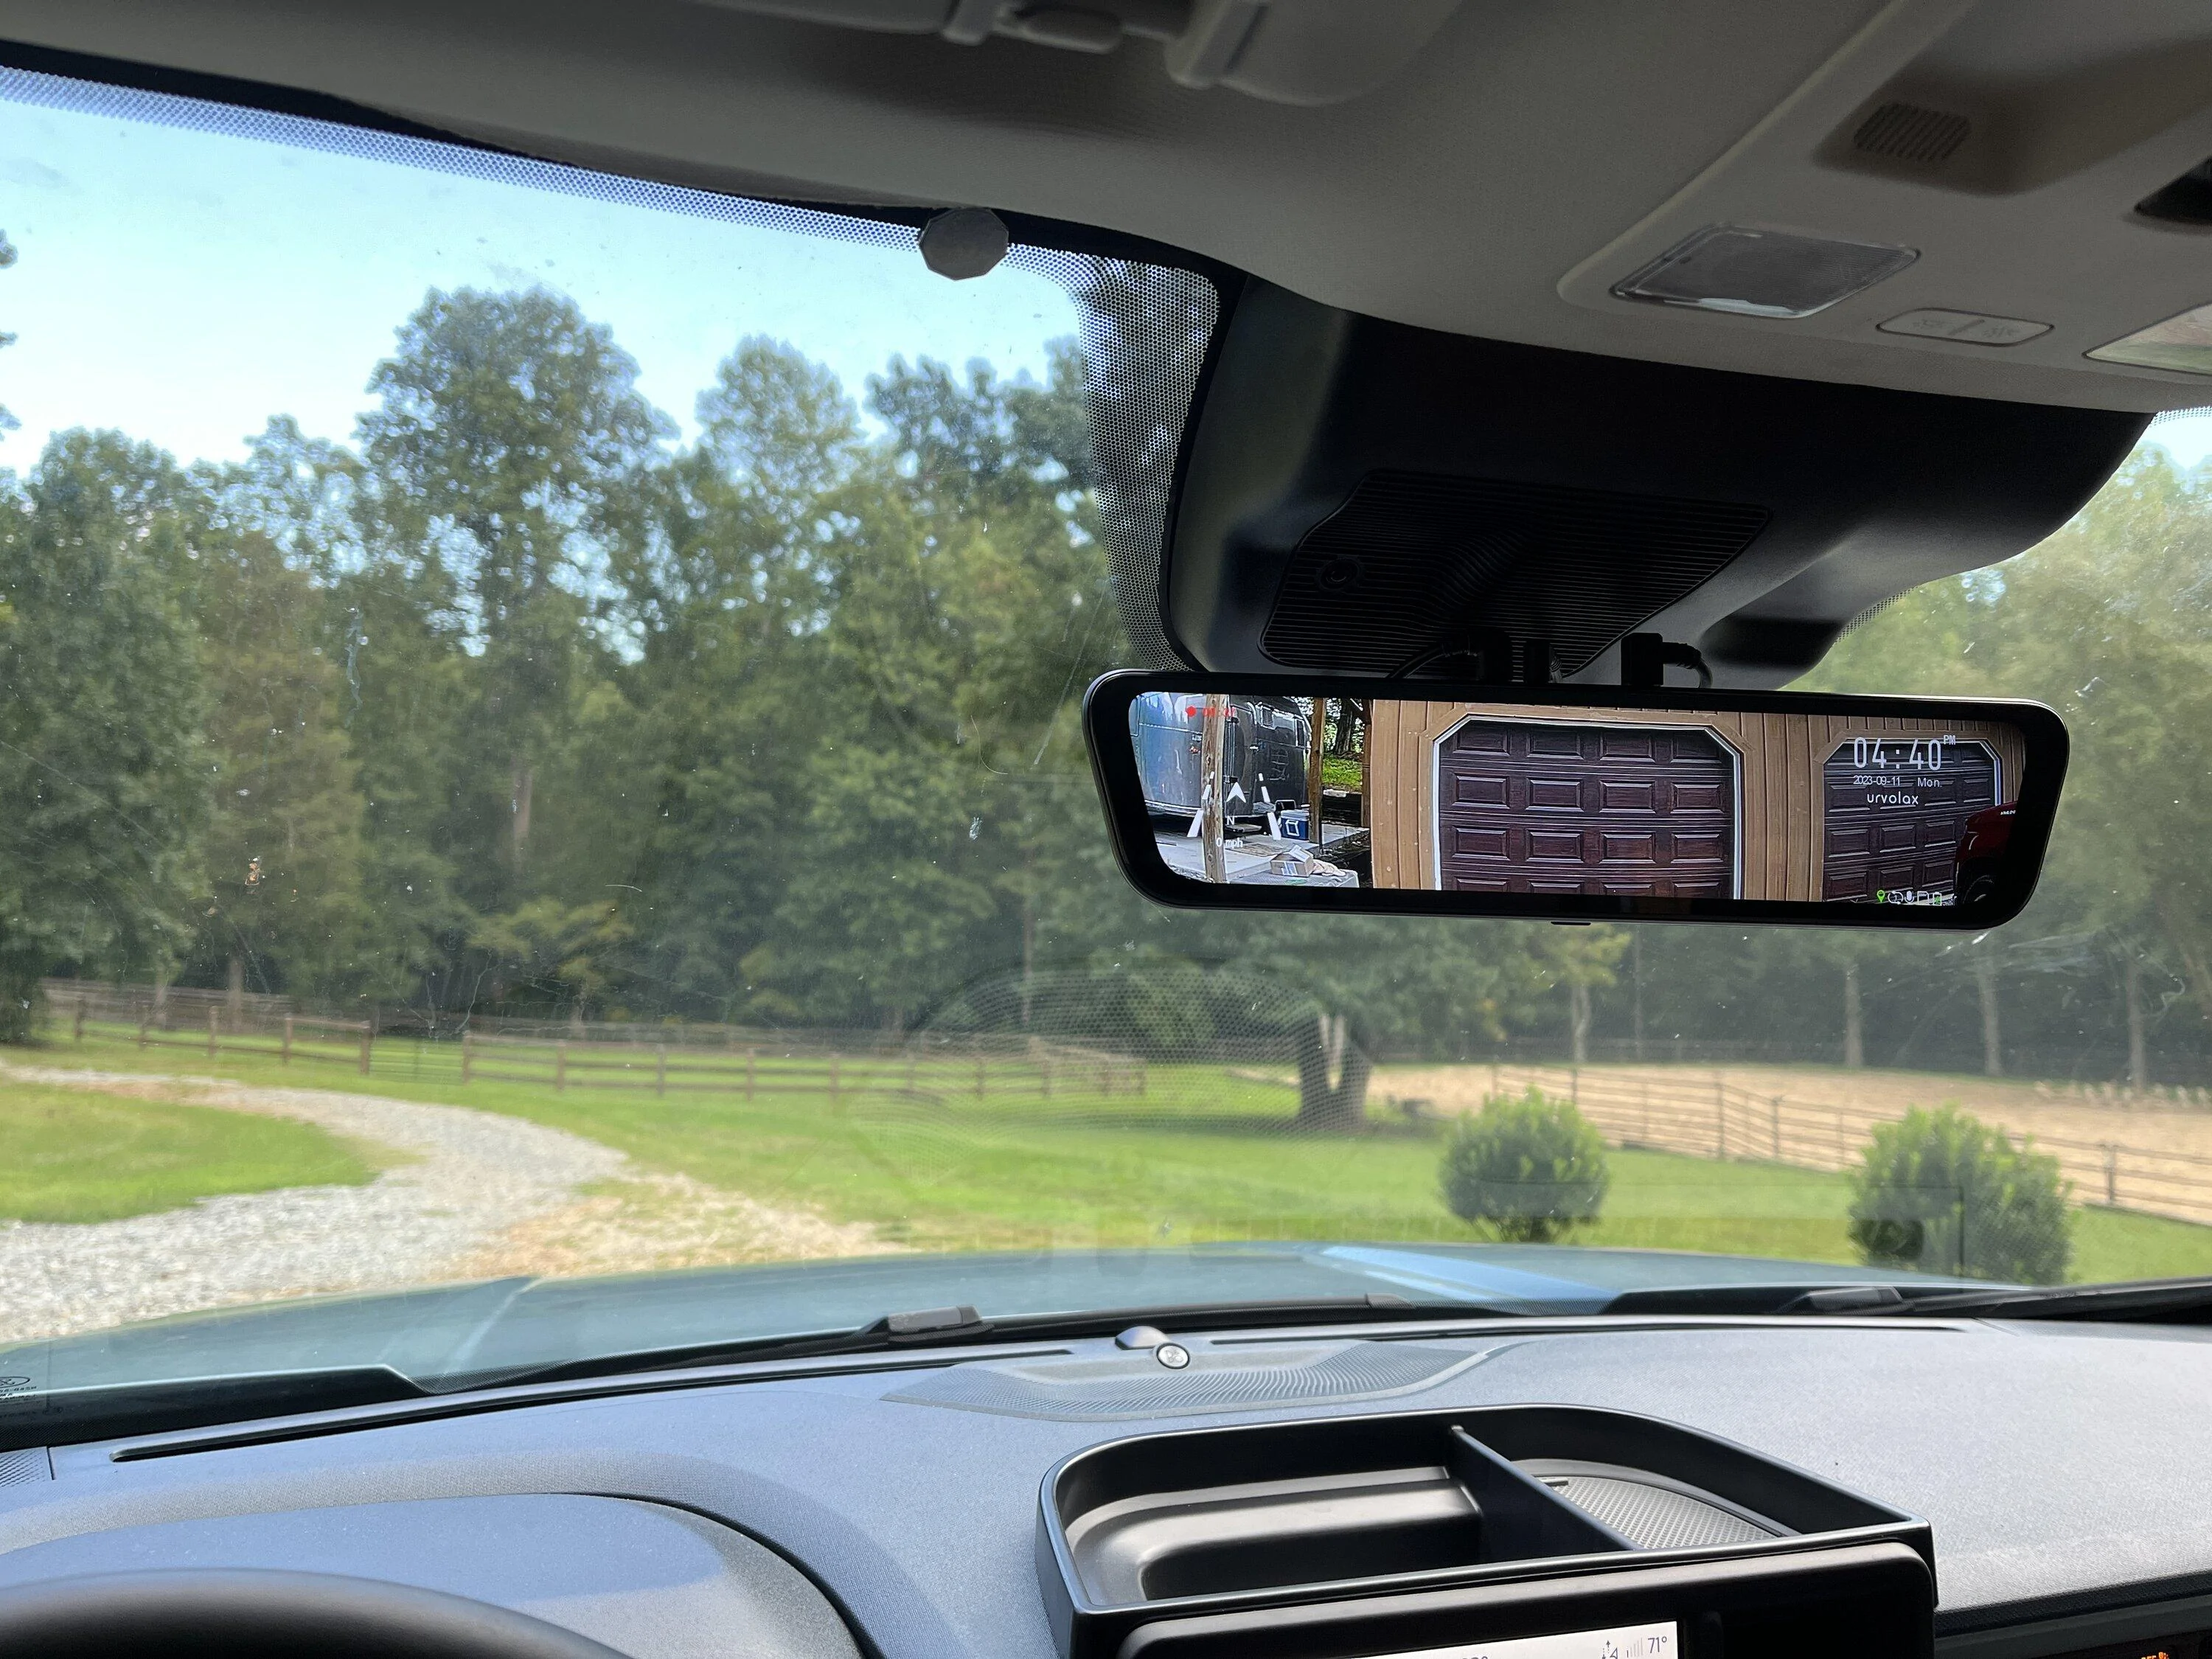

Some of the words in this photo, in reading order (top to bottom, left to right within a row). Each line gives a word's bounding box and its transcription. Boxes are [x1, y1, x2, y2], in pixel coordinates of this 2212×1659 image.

[1854, 737, 1941, 771] 04:40
[1943, 734, 1956, 745] PM
[1853, 775, 1901, 787] 2023-09-11
[1867, 790, 1919, 805] urvolax
[1226, 815, 1235, 825] N
[1215, 837, 1222, 847] 0
[1225, 837, 1243, 849] mph
[1647, 1636, 1667, 1654] 71°
